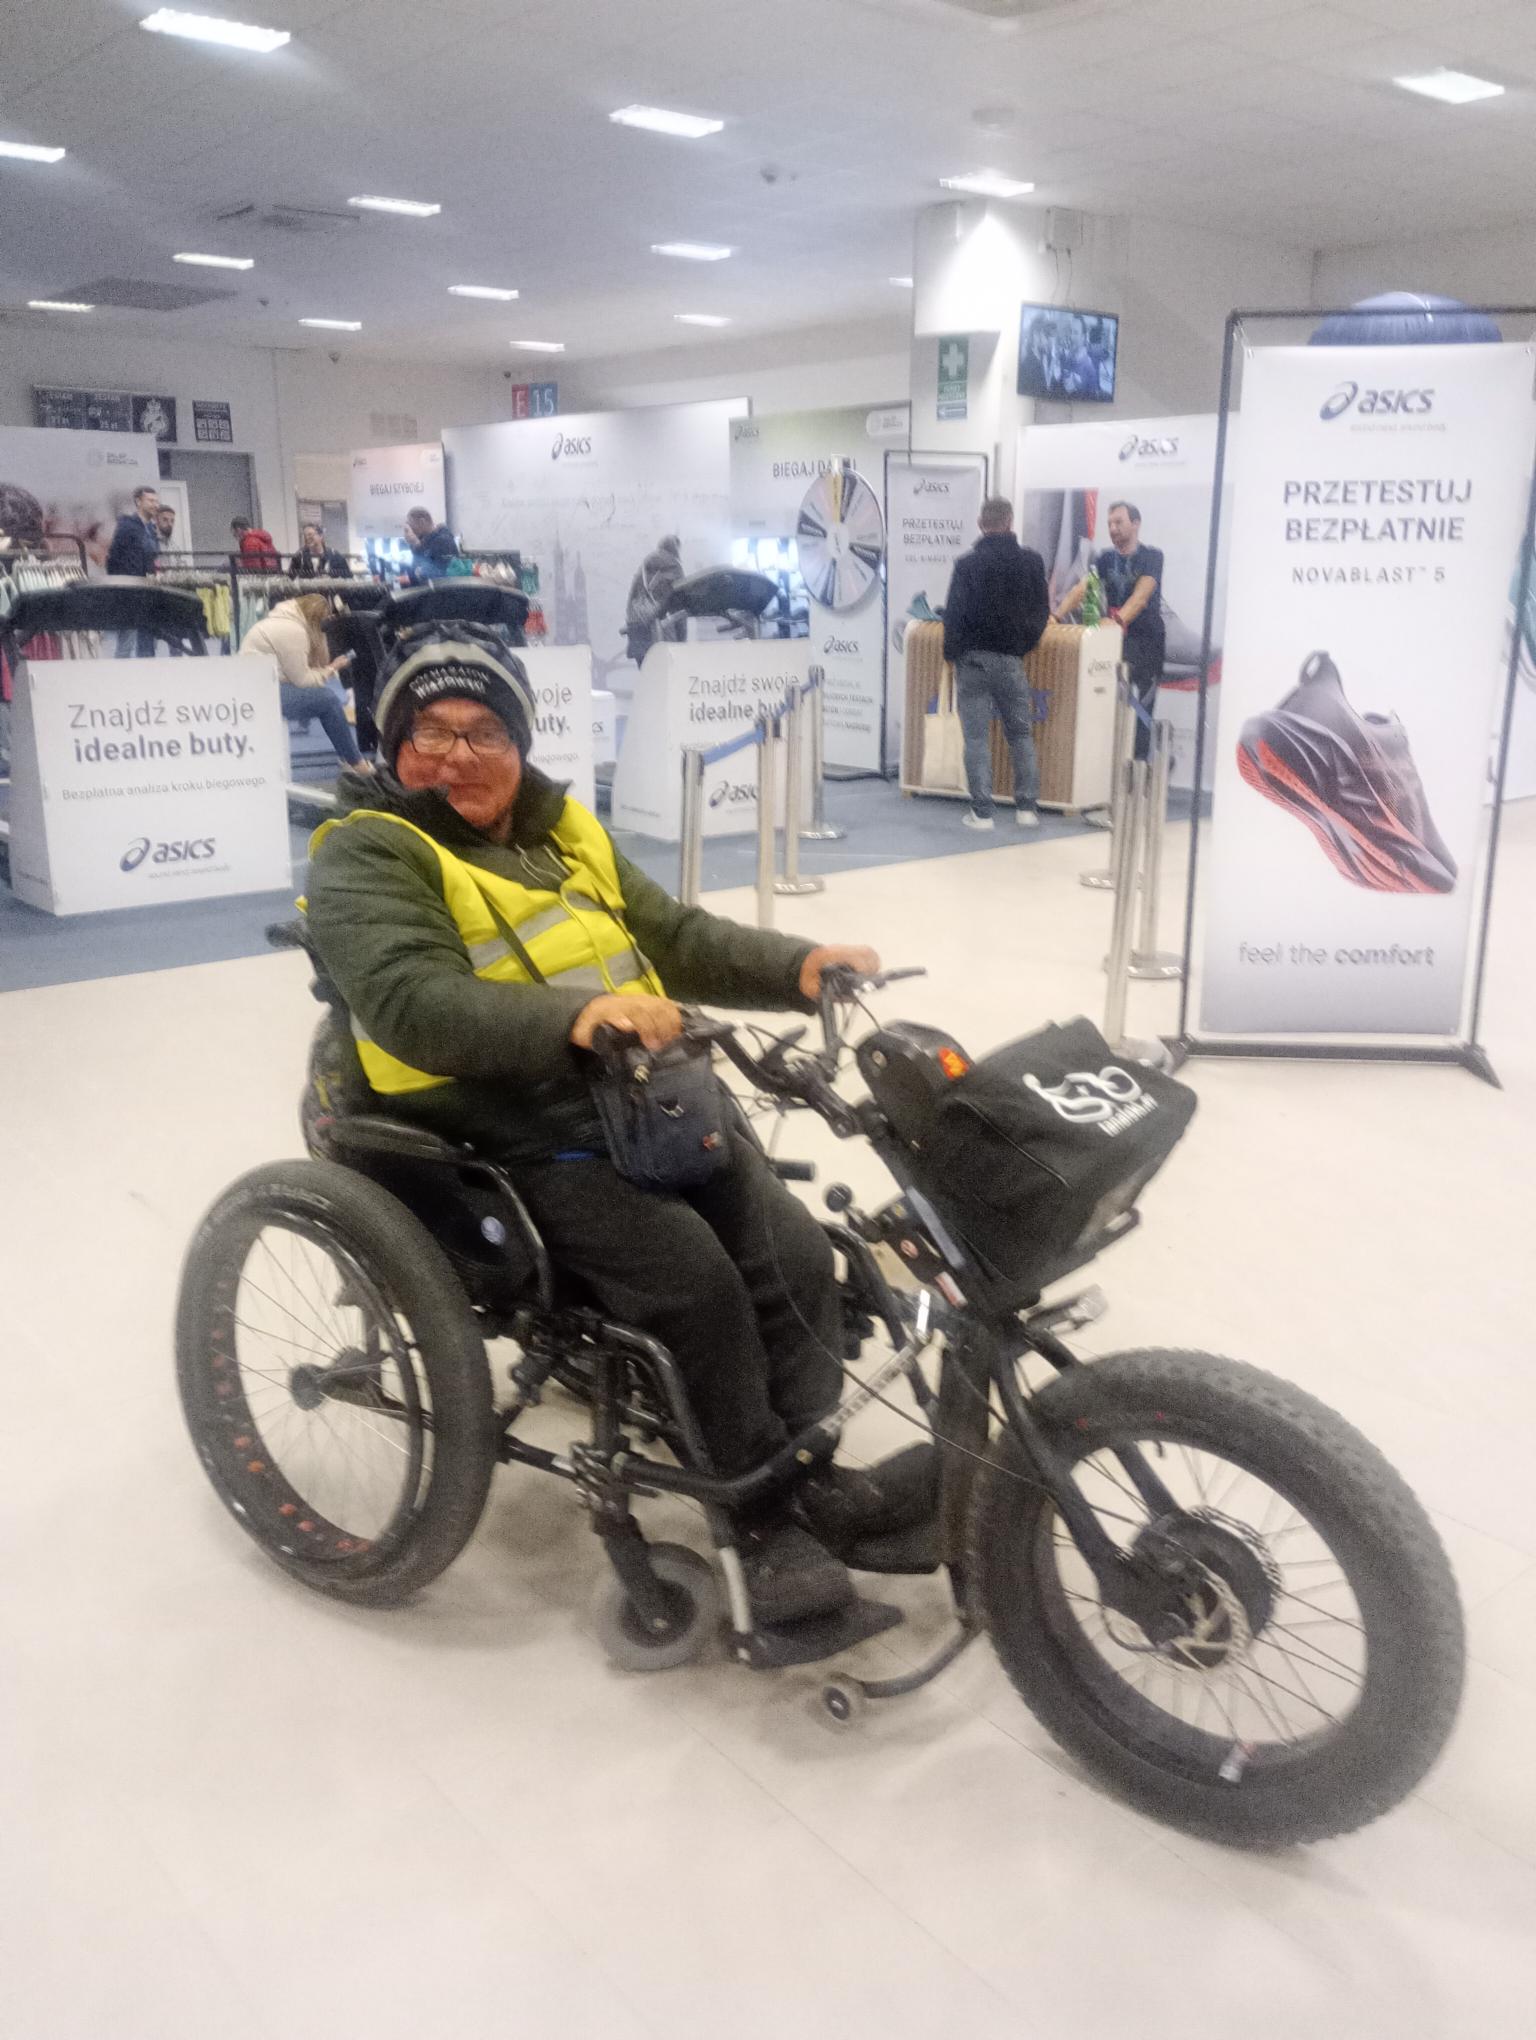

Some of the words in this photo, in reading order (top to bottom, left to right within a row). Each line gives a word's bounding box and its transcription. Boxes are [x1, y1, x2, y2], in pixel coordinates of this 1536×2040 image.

[772, 460, 815, 478] BIEGAJ
[1283, 478, 1473, 505] PRZETESTUJ
[1284, 516, 1465, 542] BEZPŁATNIE
[1433, 565, 1447, 584] 5
[688, 673, 747, 699] Znajdź
[68, 700, 167, 732] Znajdź
[176, 698, 255, 727] swoje
[690, 700, 753, 722] idealne
[534, 713, 572, 737] uty.
[74, 734, 182, 763] idealne
[189, 731, 255, 760] buty.
[1240, 941, 1282, 965] feel
[1289, 942, 1328, 965] the
[1334, 943, 1435, 967] comfort
